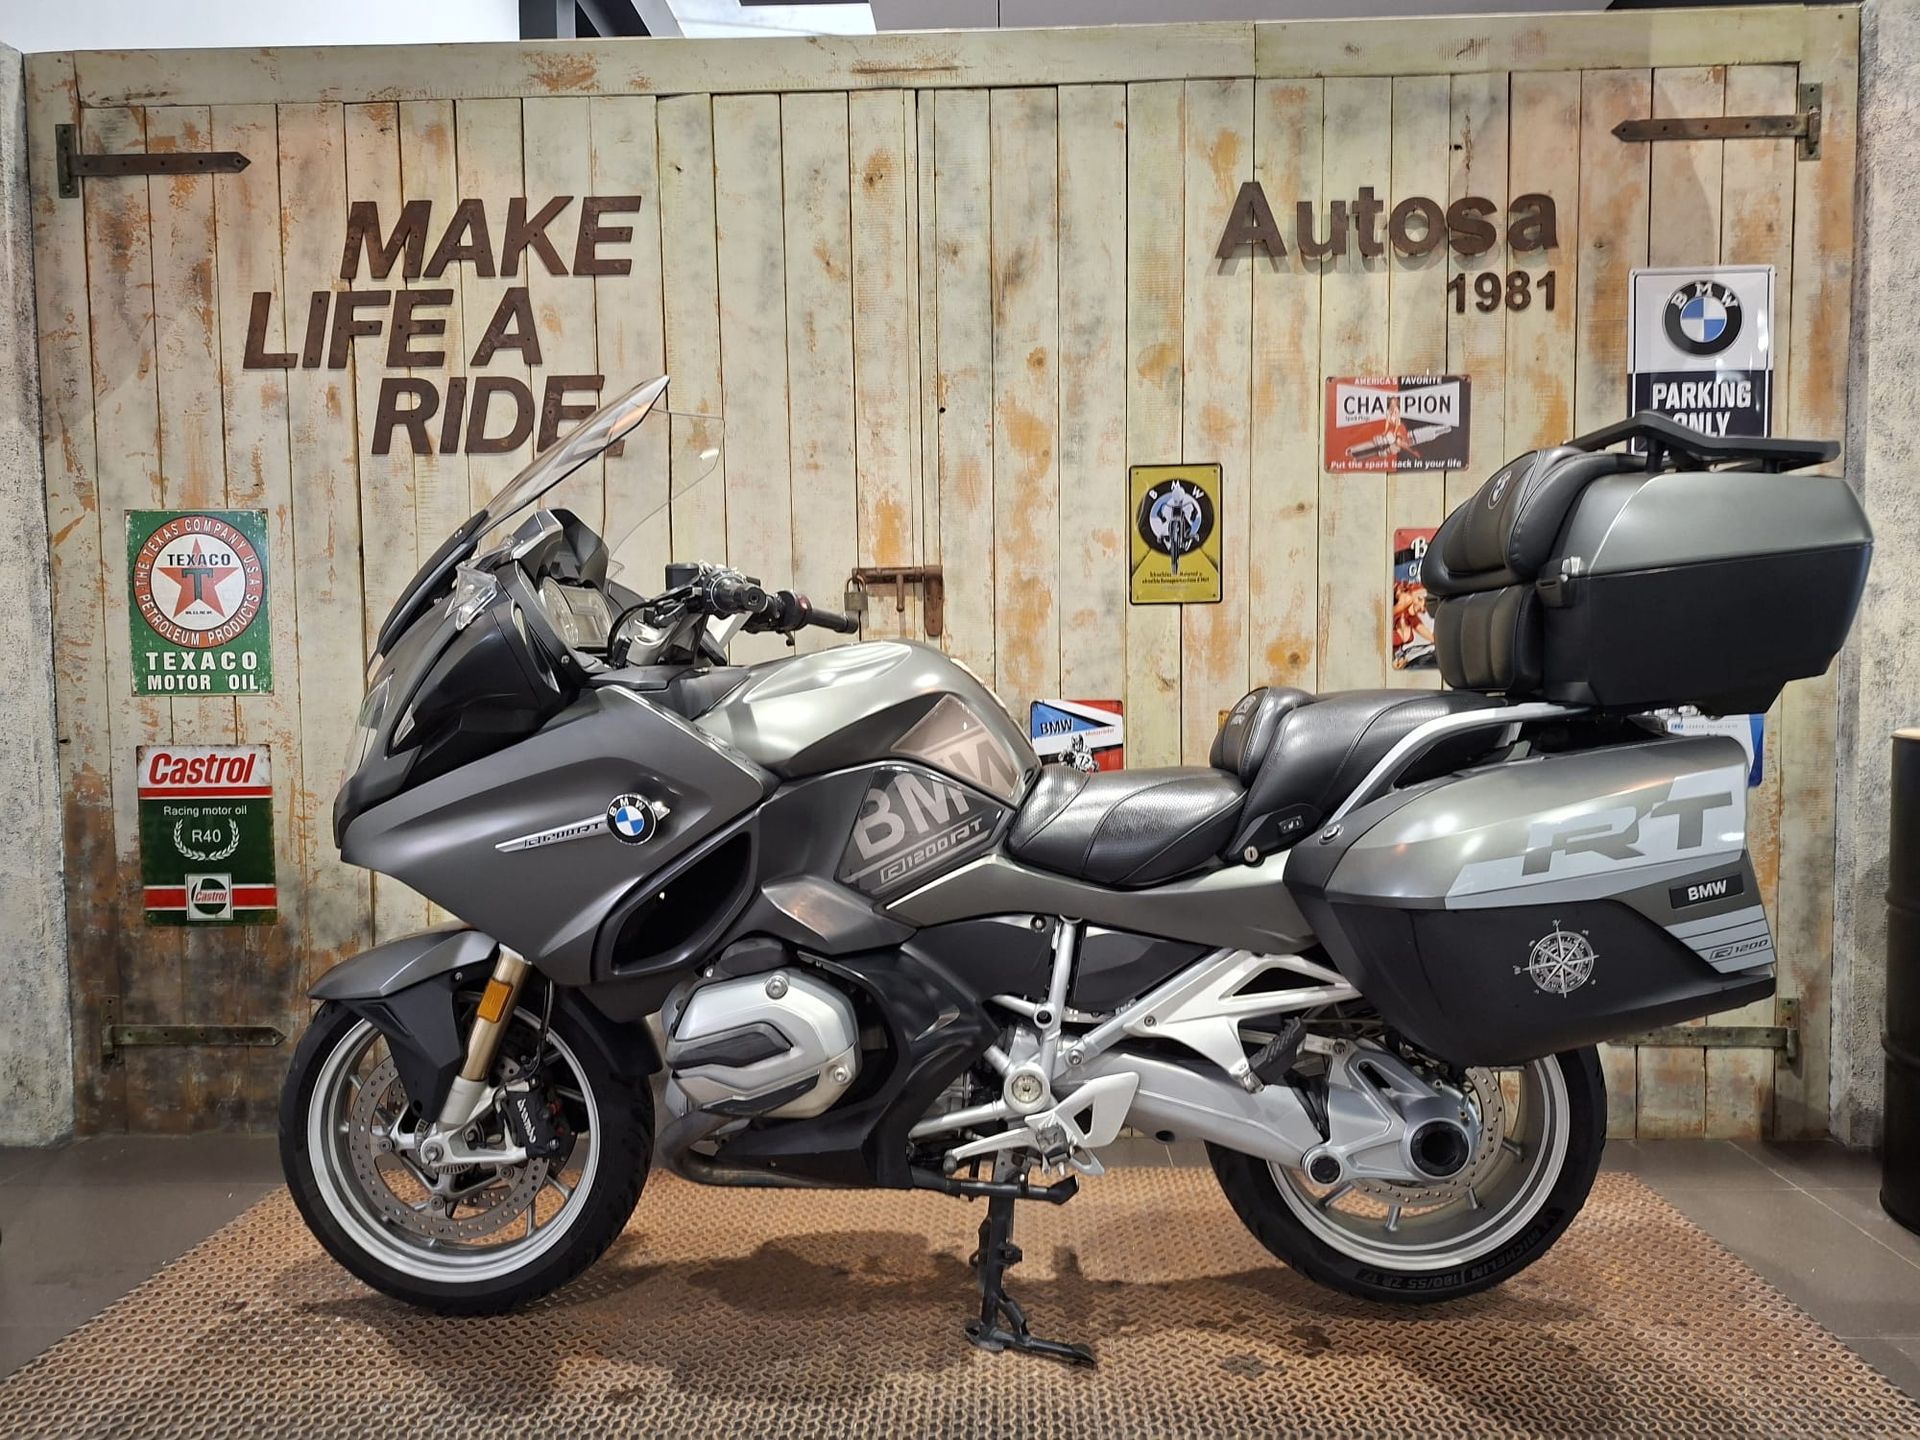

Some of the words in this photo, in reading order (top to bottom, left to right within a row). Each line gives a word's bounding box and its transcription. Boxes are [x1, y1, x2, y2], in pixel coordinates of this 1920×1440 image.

[1215, 182, 1560, 259] Autosa
[340, 196, 641, 279] MAKE
[1447, 271, 1556, 314] 1981
[1671, 282, 1739, 310] BMW
[243, 289, 454, 369] LIFE
[470, 287, 543, 367] A
[1343, 395, 1451, 415] CHAPION
[1652, 380, 1752, 410] PARKING
[371, 374, 625, 457] RIDE
[1331, 460, 1346, 470] Put
[1348, 460, 1363, 470] the
[1364, 460, 1389, 470] spark
[1391, 459, 1412, 469] back
[1413, 459, 1424, 469] in
[1425, 459, 1445, 470] your
[1447, 458, 1462, 468] life
[1148, 479, 1205, 500] BMW
[136, 561, 150, 587] THE
[144, 523, 180, 557] TEXAS
[184, 518, 247, 549] COMPANY
[167, 553, 231, 566] TEXACO
[140, 594, 200, 646] PETROLEUM
[207, 594, 259, 645] PRODUCTS
[145, 651, 258, 671] TEXACO
[147, 674, 211, 691] MOTOR
[228, 674, 259, 690] OIL
[1040, 718, 1073, 735] BMW
[149, 753, 256, 785] Castrol
[163, 805, 200, 818] Racing
[202, 806, 232, 816] motor
[235, 805, 247, 815] oil
[609, 798, 645, 817] BMW
[853, 738, 1021, 862] BMW
[191, 829, 222, 843] R40
[194, 891, 228, 902] Castrol
[1686, 879, 1728, 902] BMW
[1470, 1227, 1541, 1280] MICHELIN
